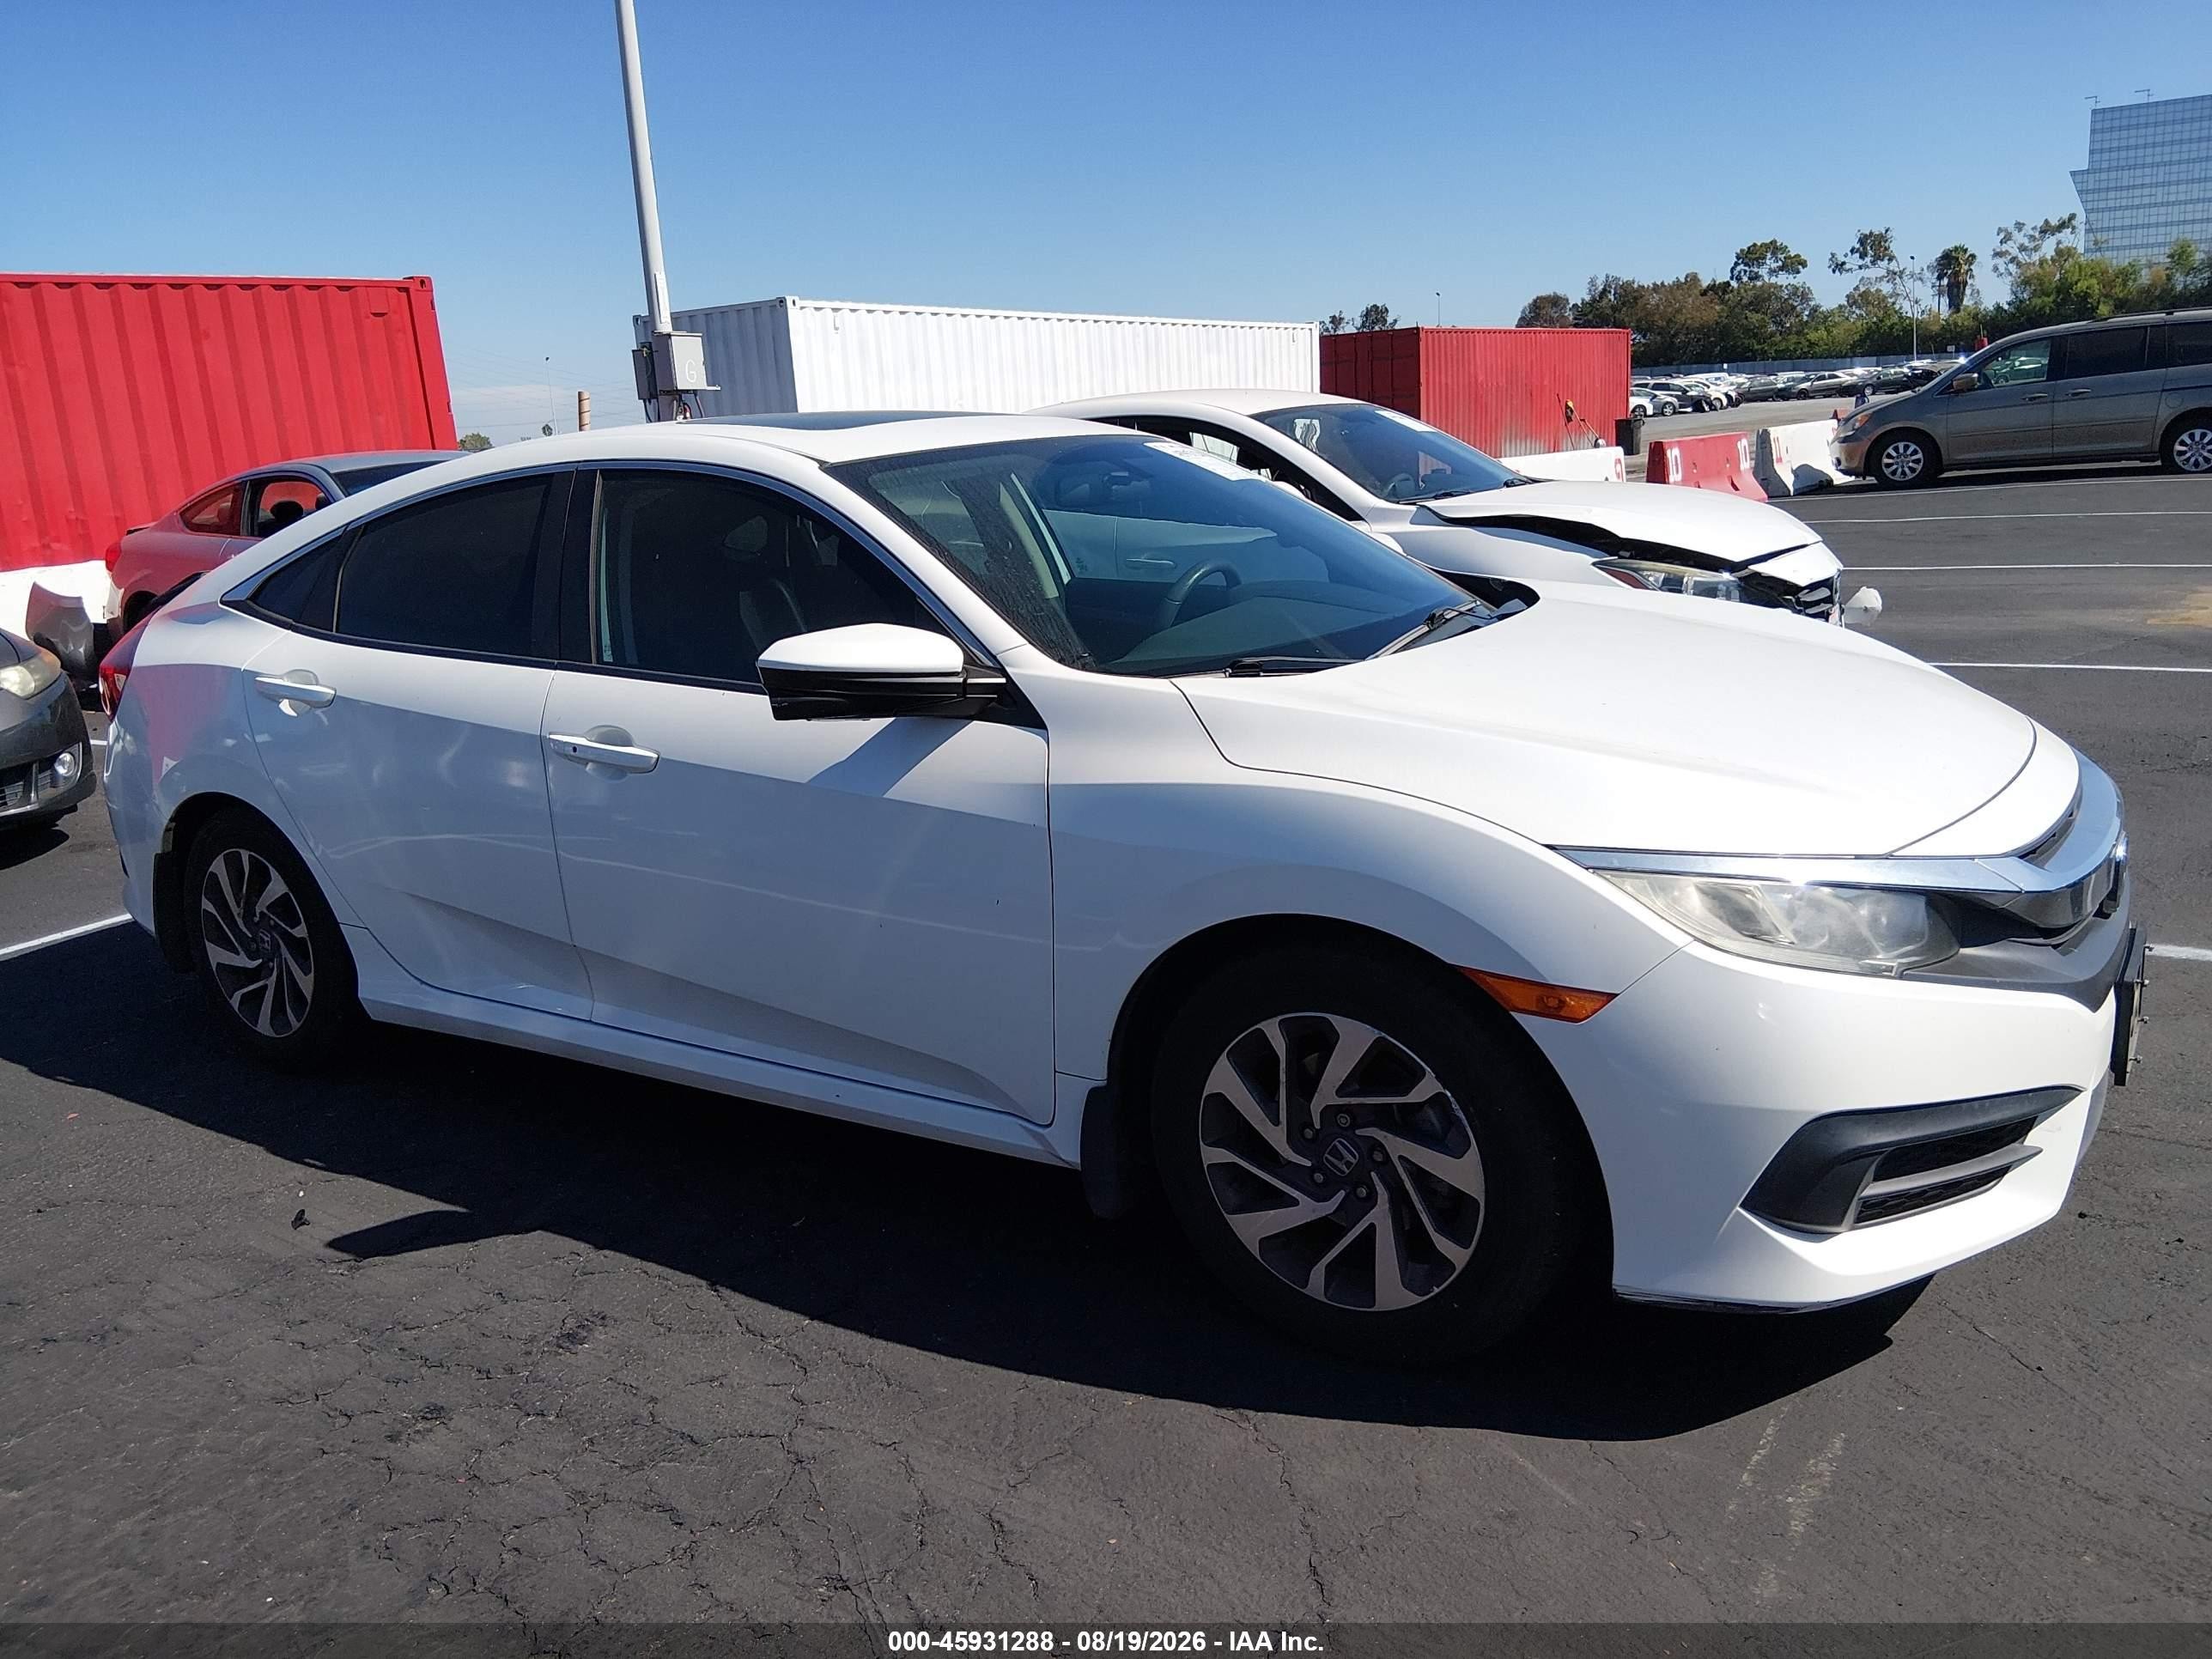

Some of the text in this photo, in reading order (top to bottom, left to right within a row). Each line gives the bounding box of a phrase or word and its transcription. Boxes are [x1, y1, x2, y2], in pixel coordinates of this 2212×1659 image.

[685, 359, 696, 383] G
[1666, 447, 1682, 483] 10
[1736, 438, 1750, 471] 10
[1772, 436, 1783, 464] 11
